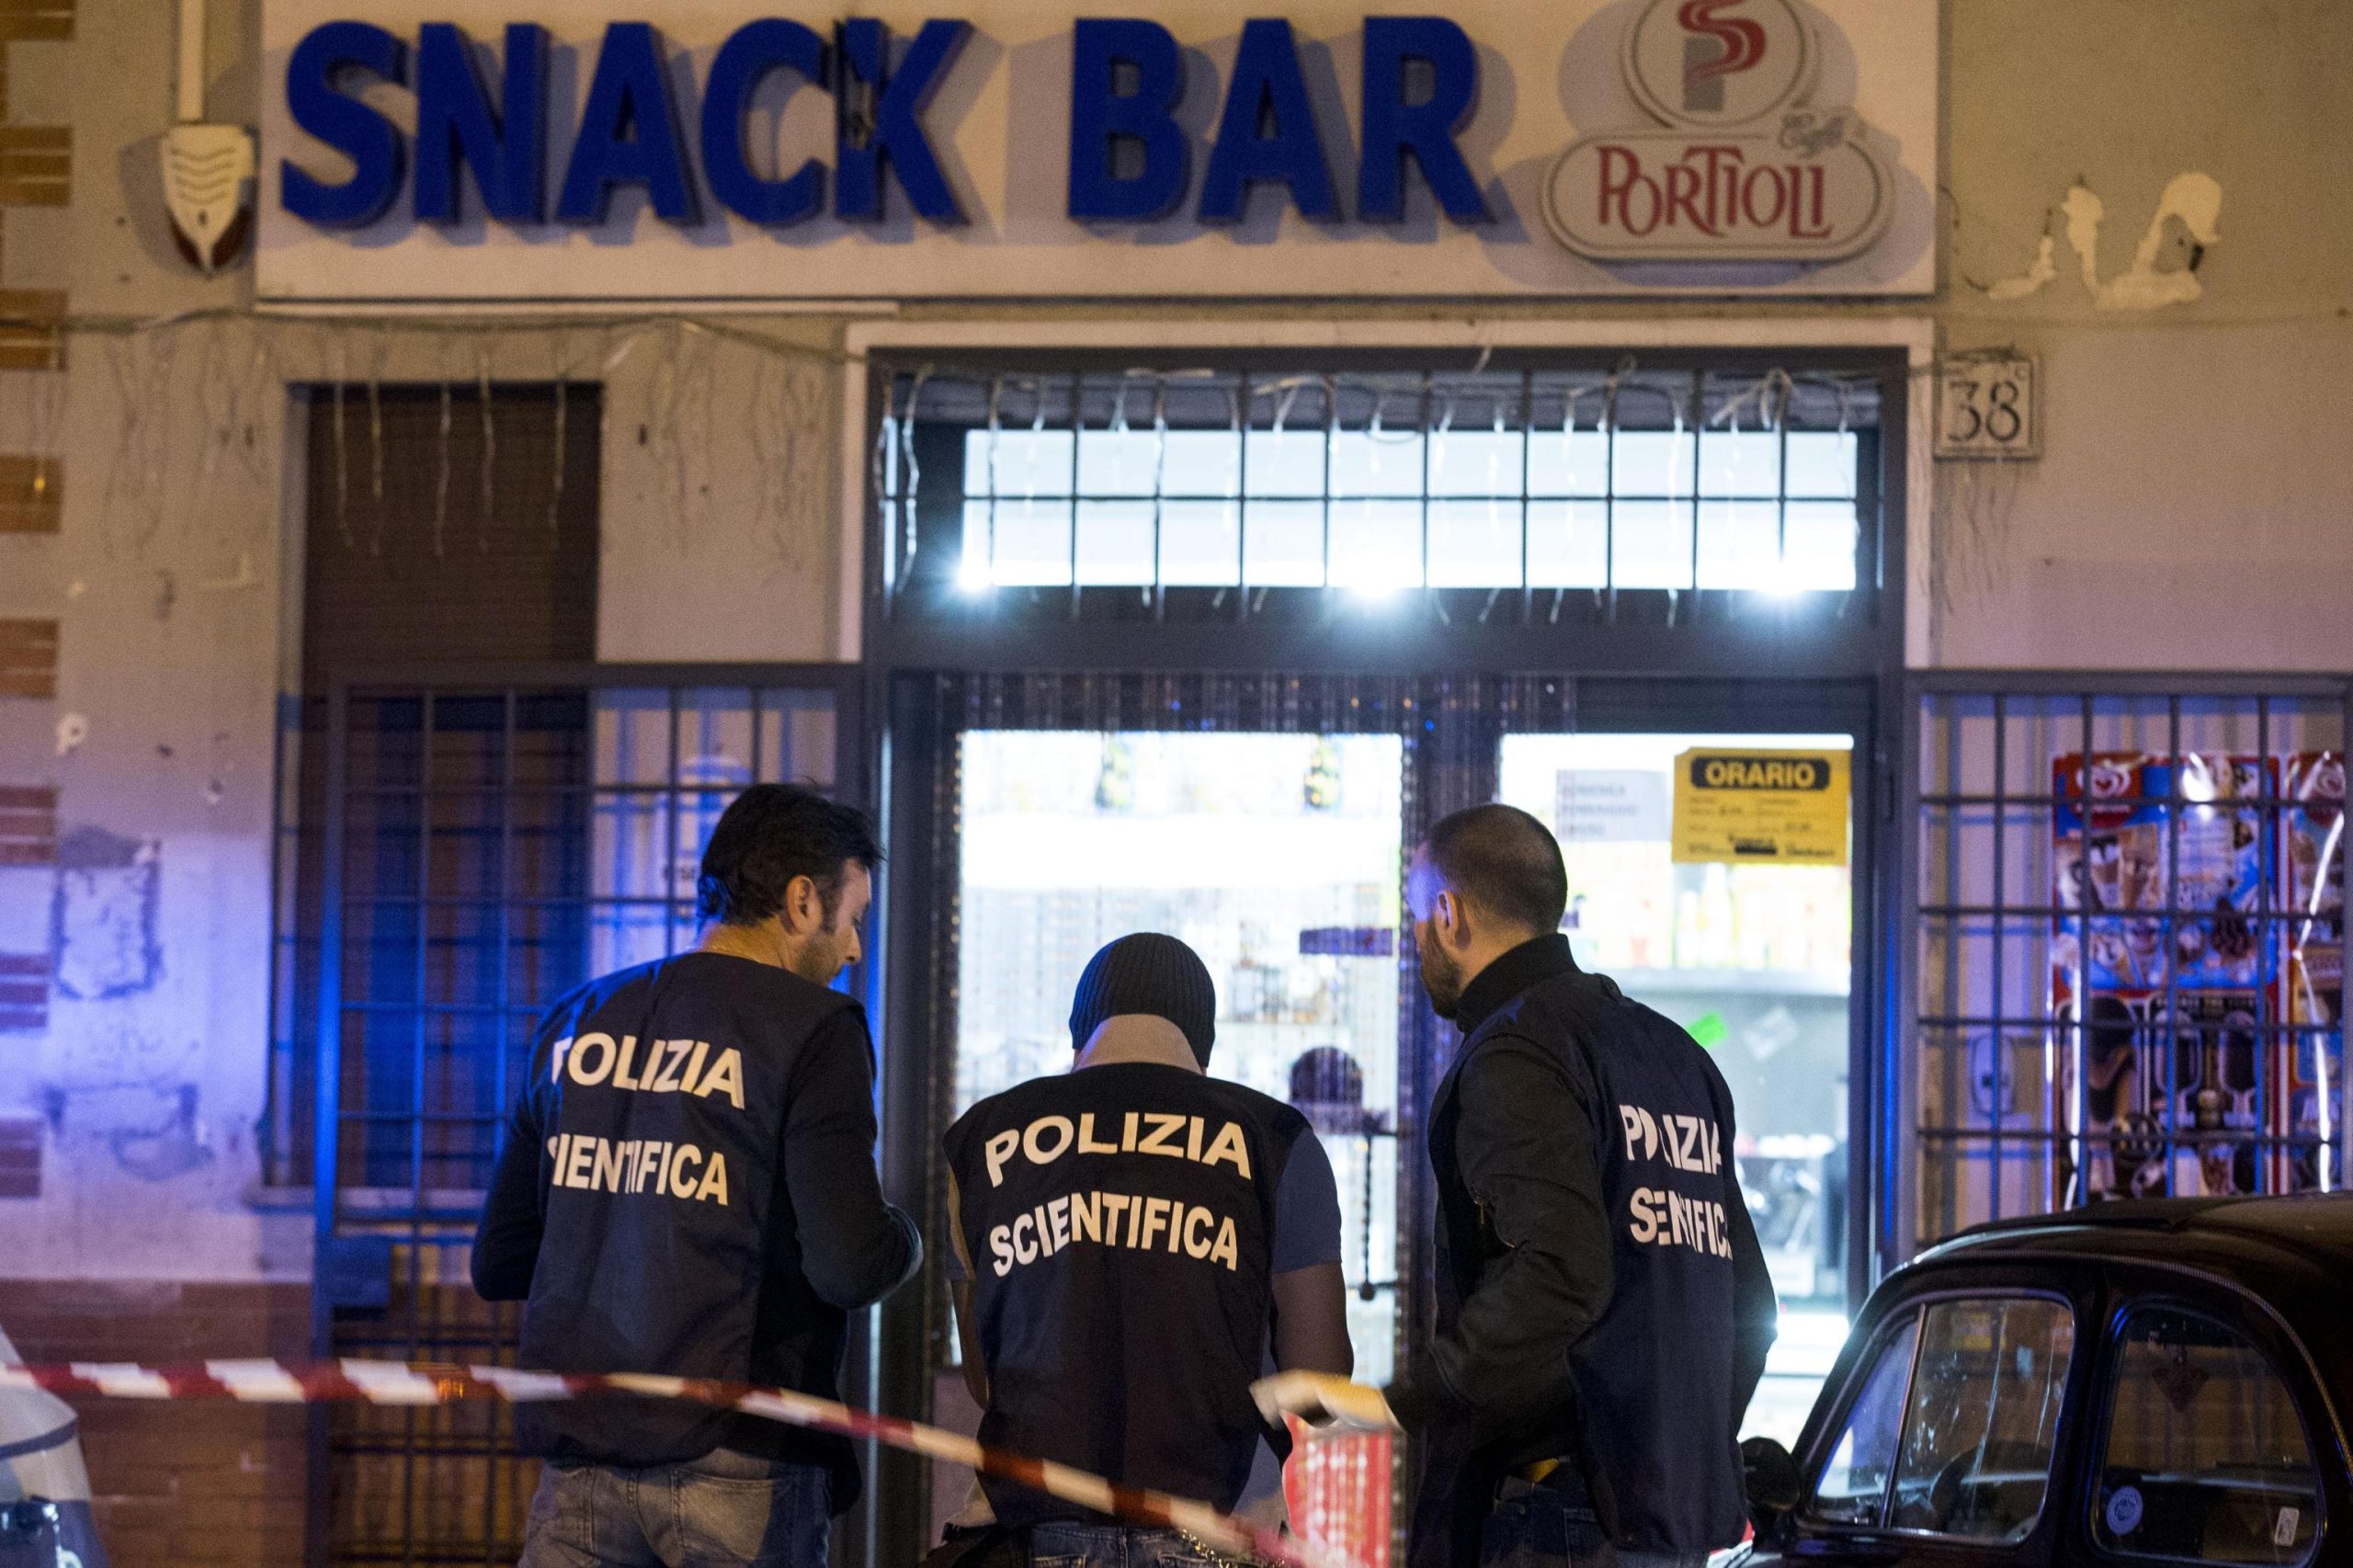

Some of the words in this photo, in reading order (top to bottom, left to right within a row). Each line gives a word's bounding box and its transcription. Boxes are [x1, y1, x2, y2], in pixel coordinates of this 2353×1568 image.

[279, 17, 972, 232] SNACK
[1067, 17, 1496, 226] BAR
[1596, 145, 1833, 239] PORTIOLI
[1948, 380, 2021, 442] 38
[1704, 761, 1817, 788] ORARIO
[985, 1111, 1252, 1187] POLIZIA
[990, 1190, 1238, 1277] SCIENTIFICA
